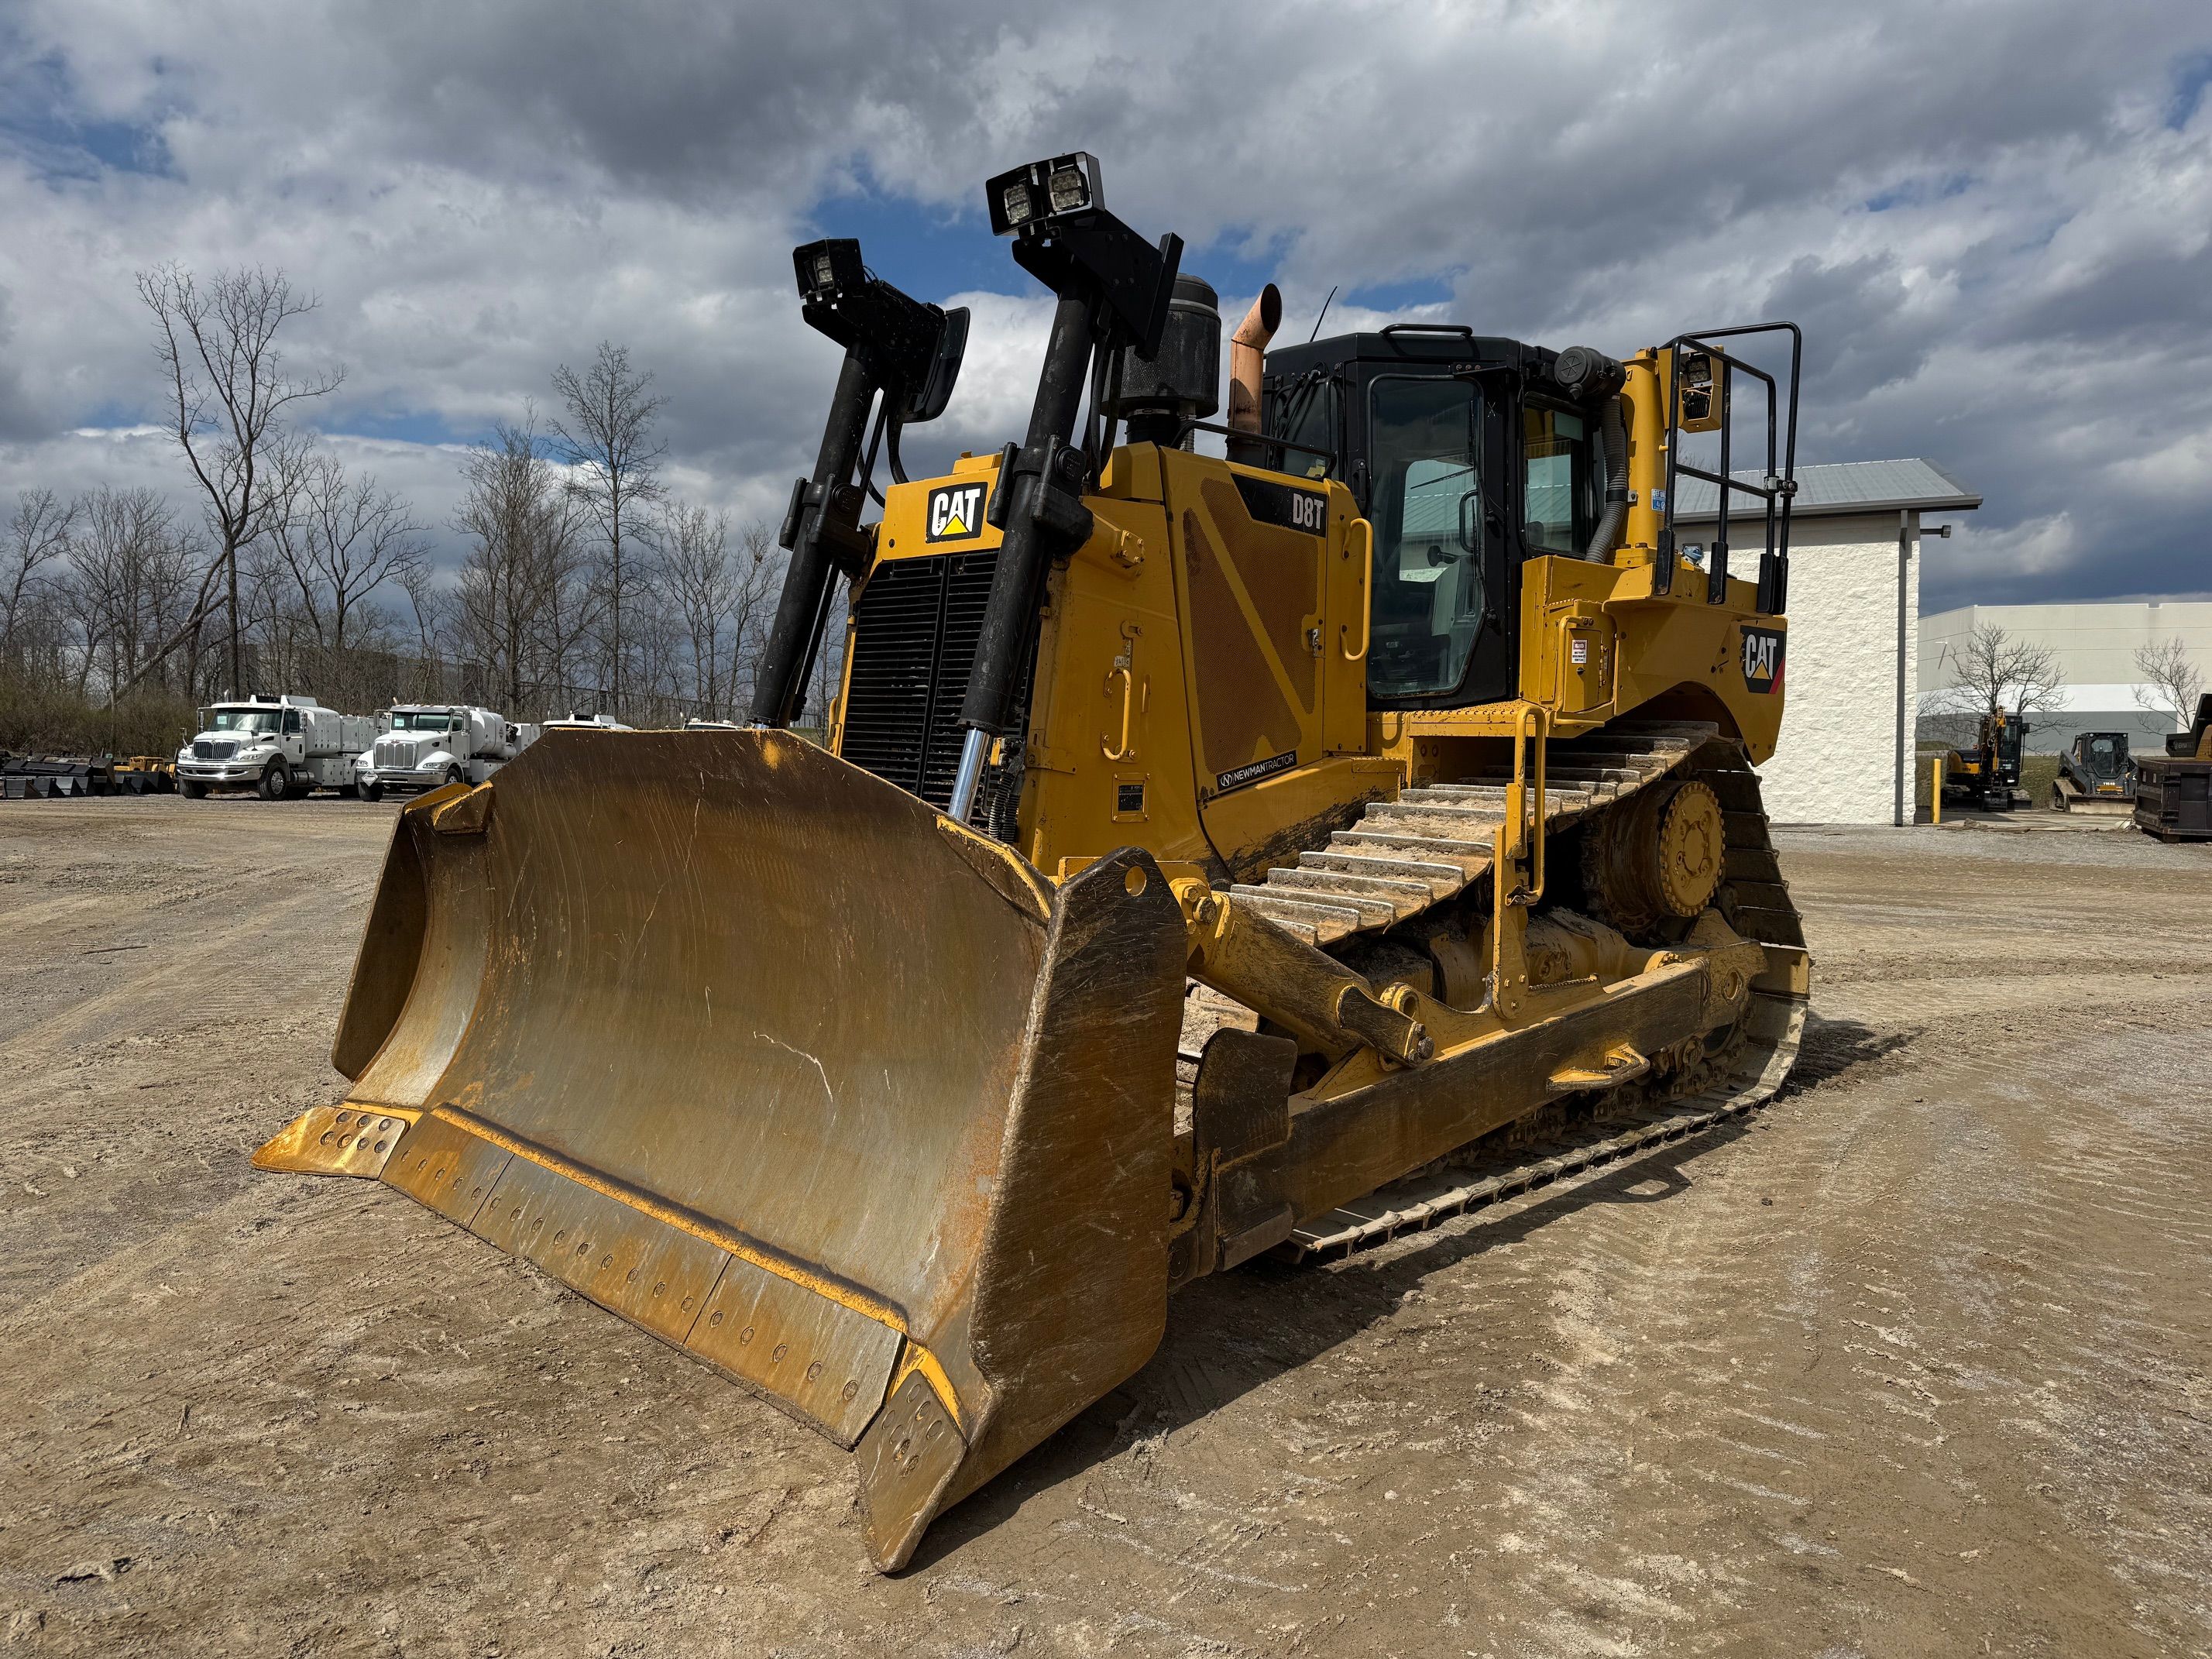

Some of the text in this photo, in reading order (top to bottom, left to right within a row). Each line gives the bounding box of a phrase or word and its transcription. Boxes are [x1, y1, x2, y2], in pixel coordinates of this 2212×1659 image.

[931, 488, 981, 537] CAT
[1293, 493, 1324, 530] D8T
[1745, 634, 1778, 680] CAT
